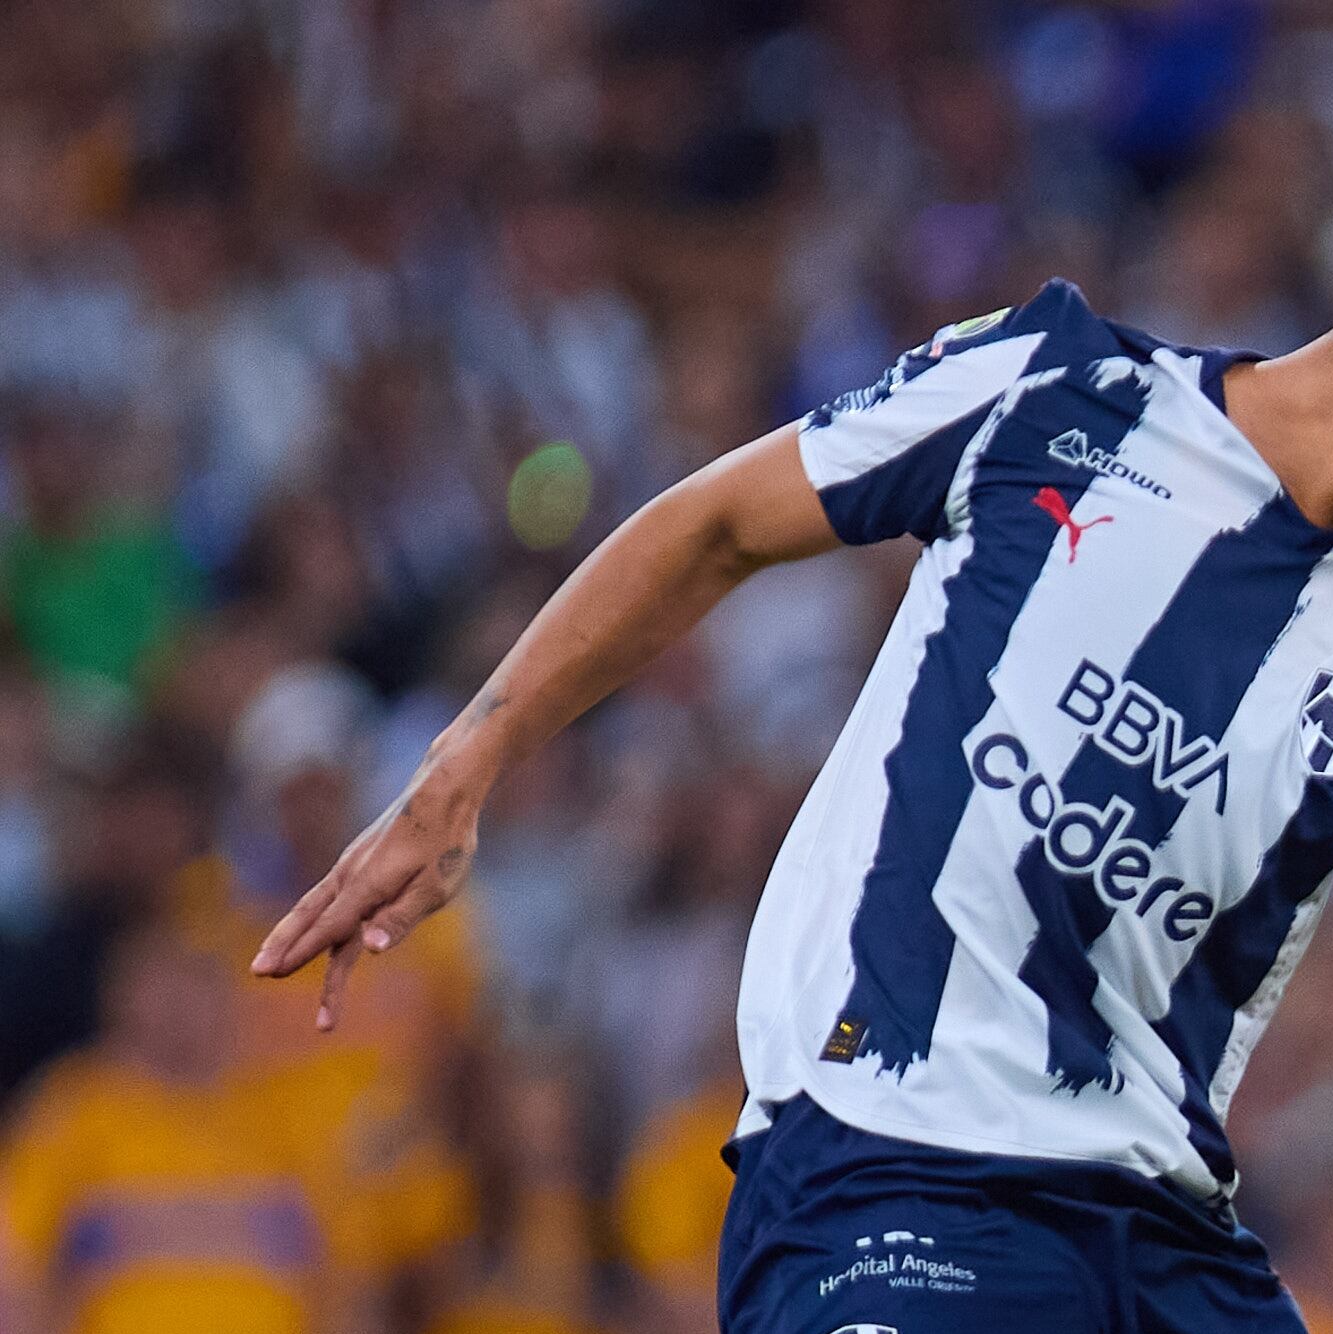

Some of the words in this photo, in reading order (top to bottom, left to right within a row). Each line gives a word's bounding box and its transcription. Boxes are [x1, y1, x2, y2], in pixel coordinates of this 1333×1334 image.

[1057, 657, 1229, 816] BBVA
[972, 733, 1214, 942] codere
[902, 1253, 976, 1281] Angeles
